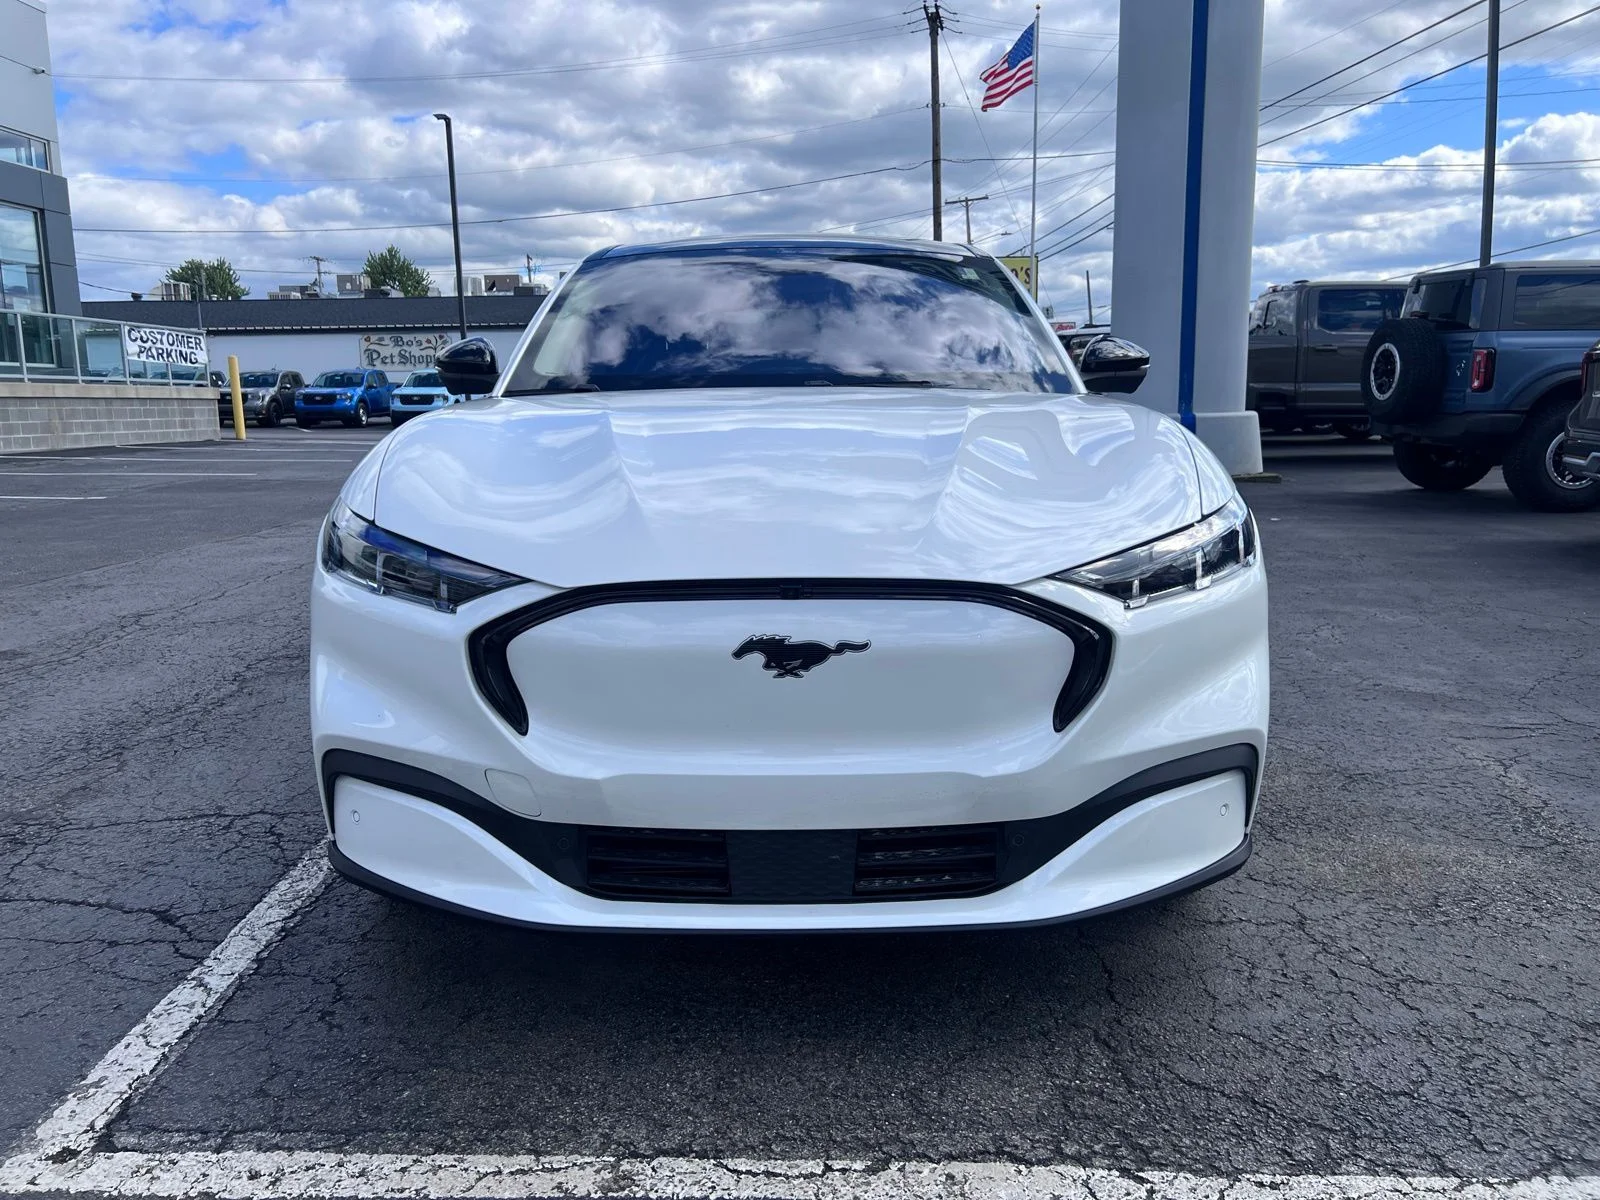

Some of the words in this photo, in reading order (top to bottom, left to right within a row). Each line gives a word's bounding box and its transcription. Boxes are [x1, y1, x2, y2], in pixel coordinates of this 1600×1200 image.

[128, 327, 204, 351] CUSTOMER
[389, 335, 423, 348] Bo's
[137, 345, 198, 365] PARKING
[363, 348, 396, 367] Pet
